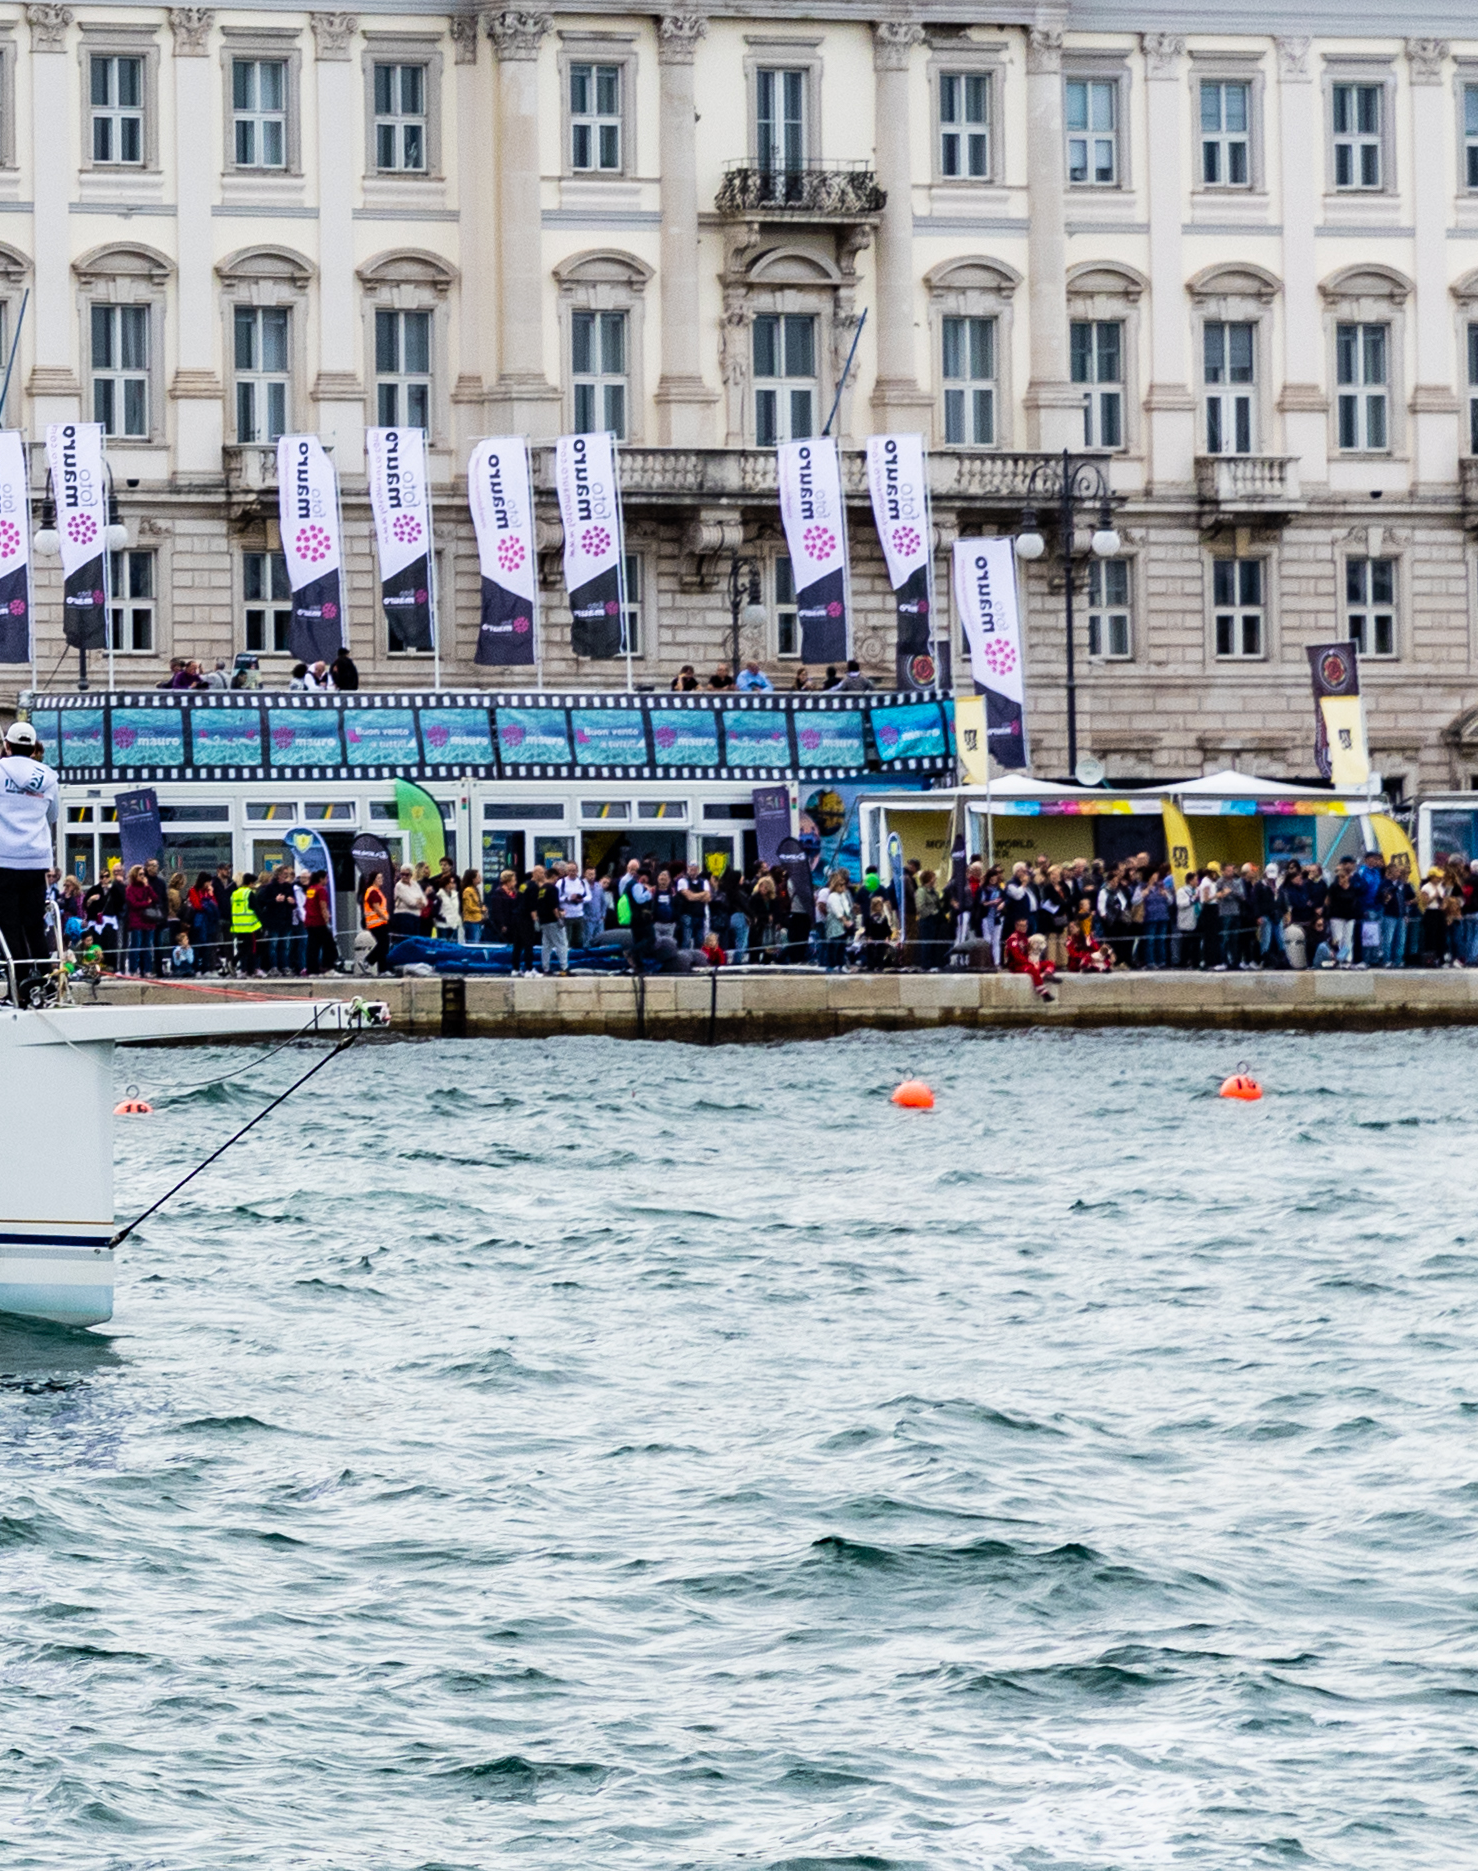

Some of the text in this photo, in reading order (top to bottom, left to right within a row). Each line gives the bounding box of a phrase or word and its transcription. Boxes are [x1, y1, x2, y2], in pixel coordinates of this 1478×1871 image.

[355, 727, 410, 736] Buon vento
[583, 727, 639, 736] Buon vento
[137, 737, 180, 747] mauro
[295, 737, 337, 747] mauro
[450, 736, 489, 746] mauro
